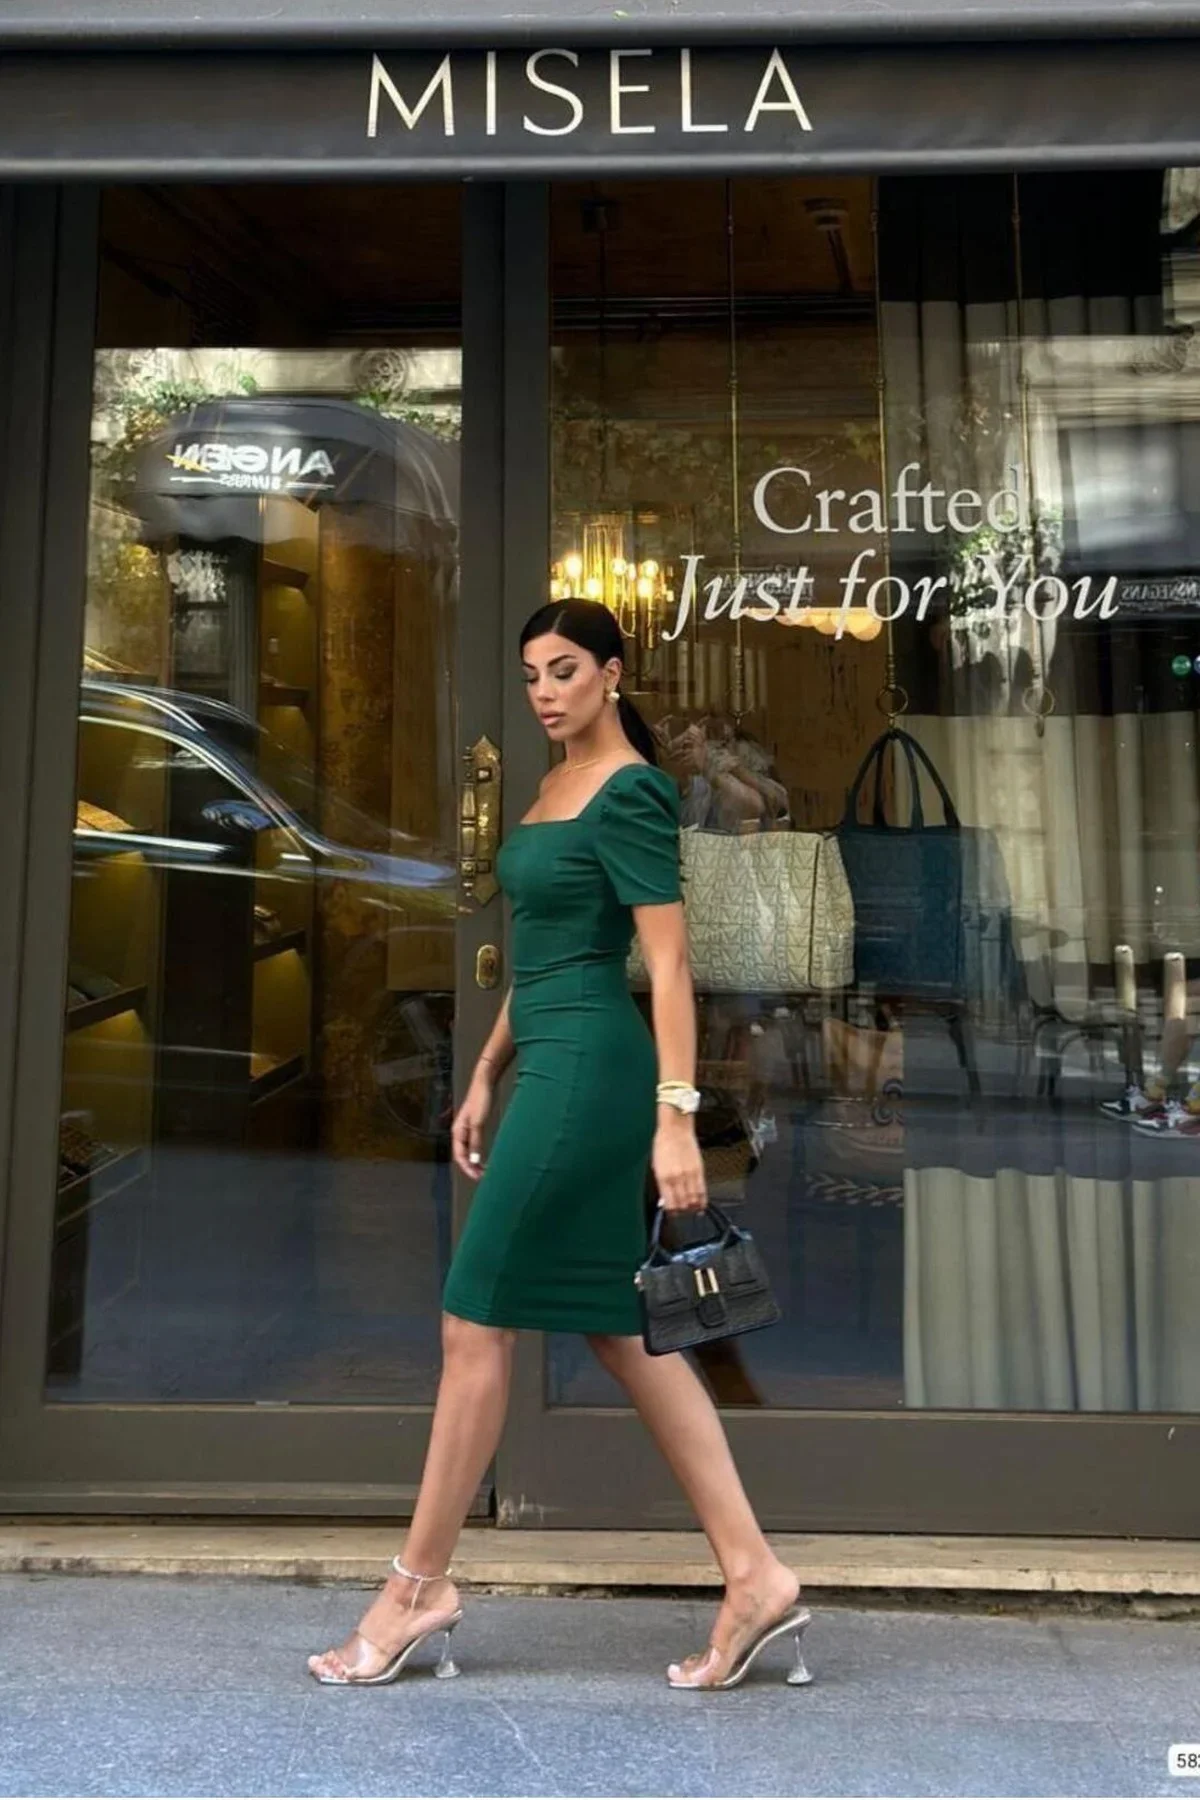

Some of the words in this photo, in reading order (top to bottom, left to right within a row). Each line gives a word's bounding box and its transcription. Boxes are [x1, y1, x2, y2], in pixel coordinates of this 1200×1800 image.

[367, 47, 813, 138] MISELA
[753, 462, 1031, 534] Crafted
[661, 553, 815, 642] Just
[834, 549, 947, 641] for
[976, 553, 1119, 621] You
